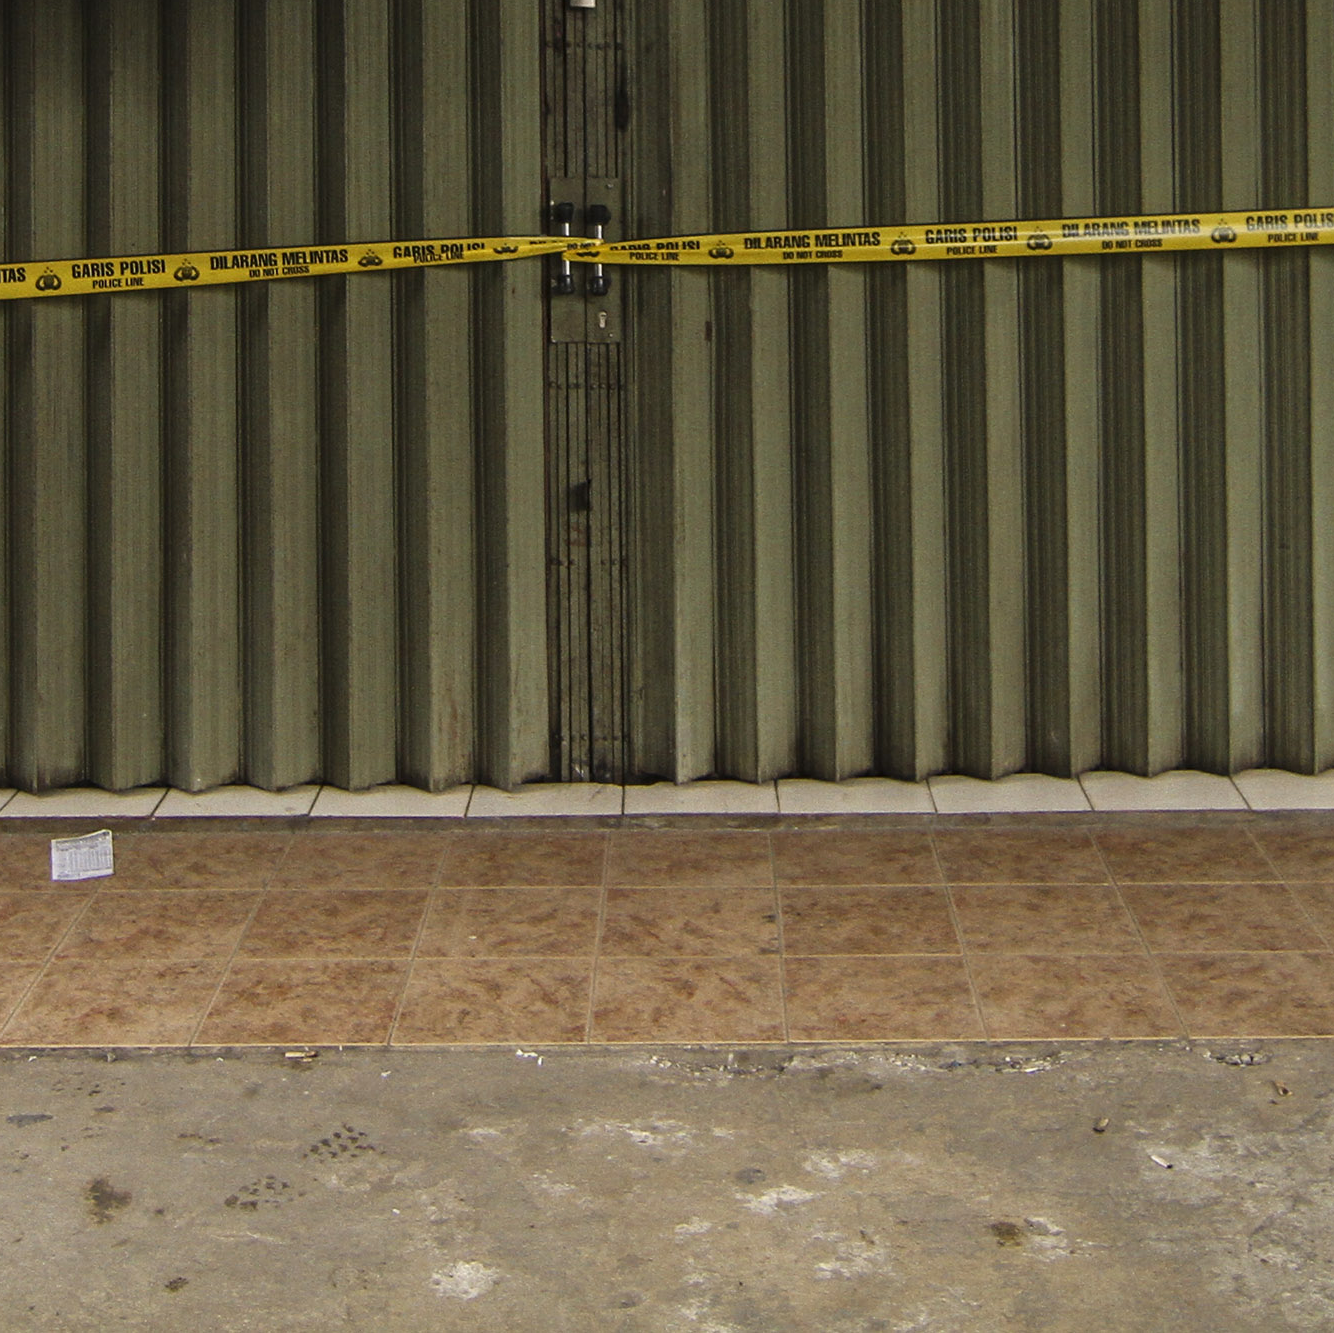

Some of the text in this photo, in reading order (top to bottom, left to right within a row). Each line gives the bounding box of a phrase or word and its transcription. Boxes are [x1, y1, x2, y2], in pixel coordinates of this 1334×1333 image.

[1246, 216, 1288, 231] GARIS
[744, 232, 881, 250] DILARANG MELINTAS
[925, 226, 1018, 244] GARIS POLISI
[1267, 232, 1320, 243] POLICE LINE
[629, 252, 680, 261] POLICE LINE
[946, 244, 998, 255] POLICE LINE
[210, 249, 349, 270] DILARANG MELINTAS
[71, 259, 166, 279] GARIS POLISI
[92, 276, 145, 289] POLICE LINE
